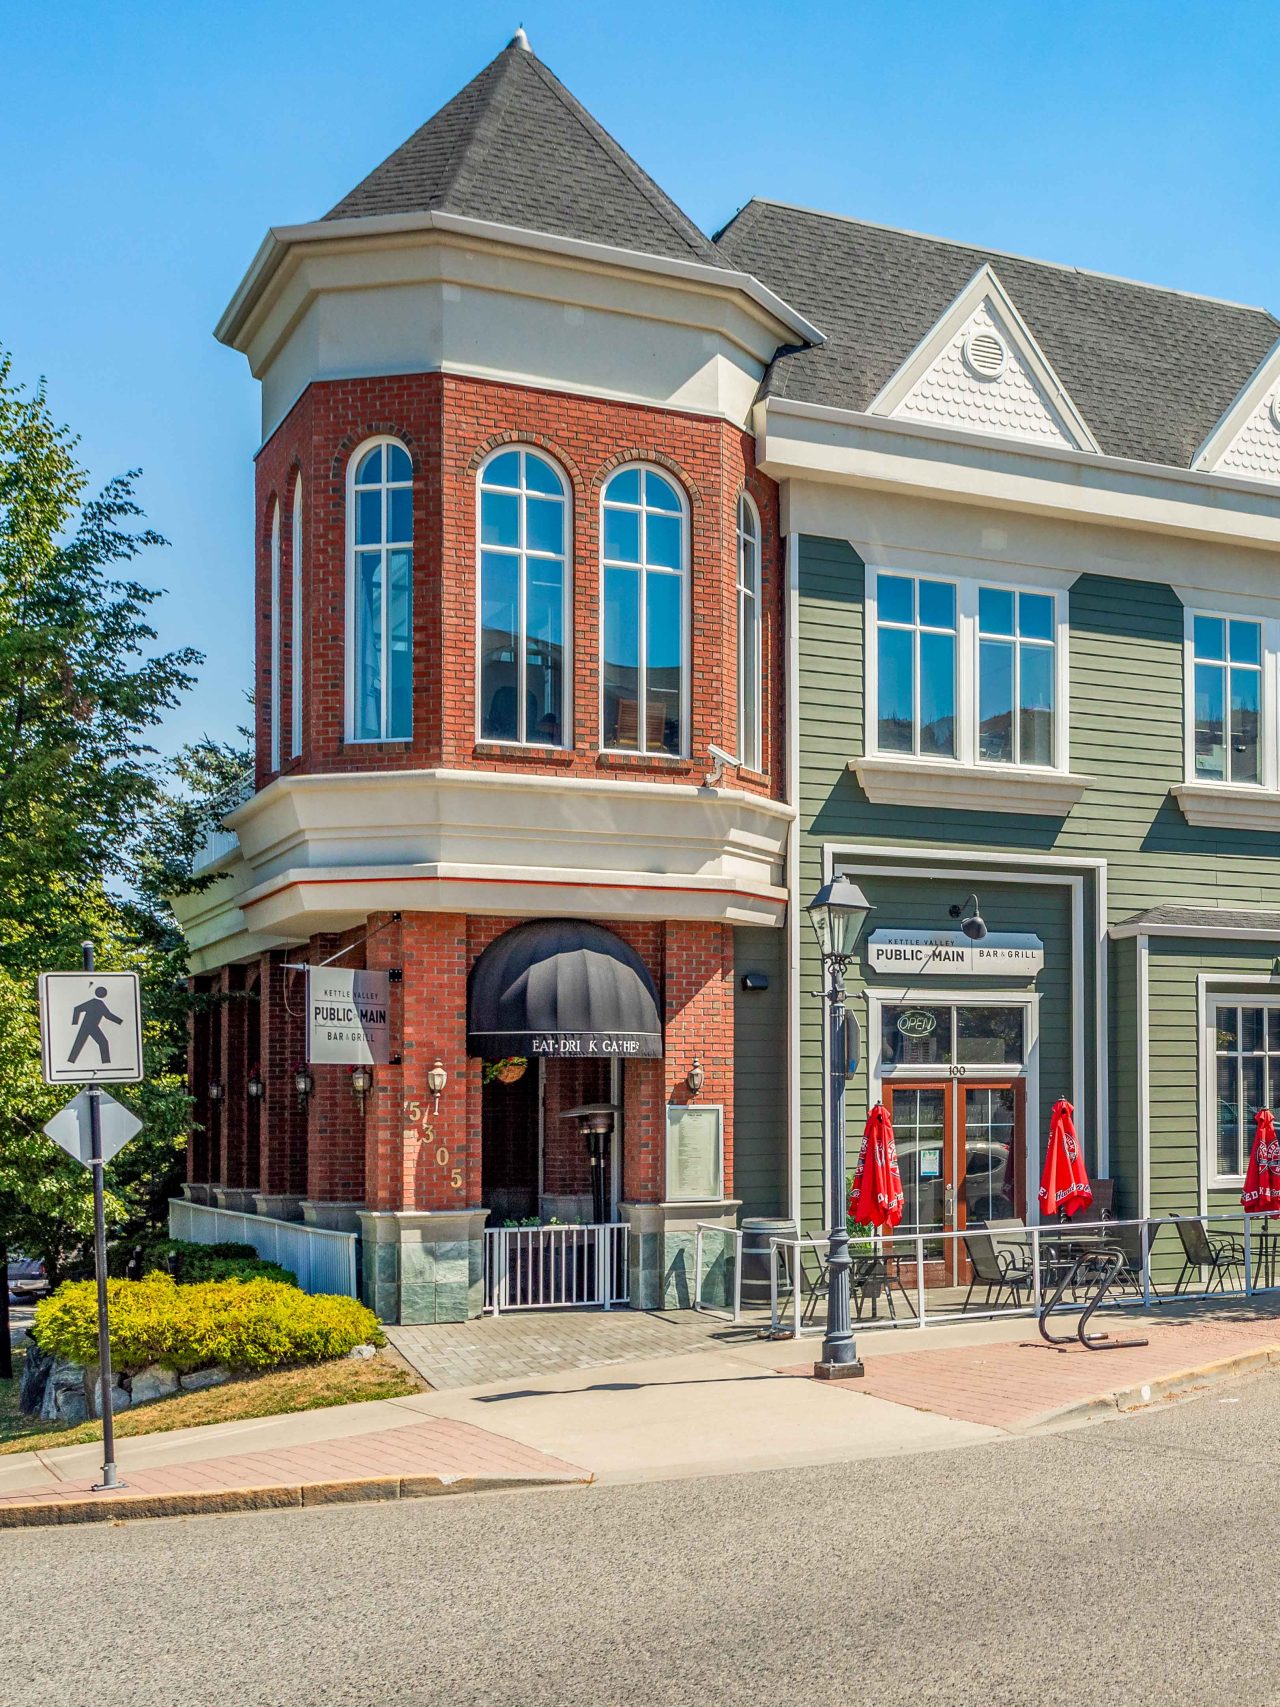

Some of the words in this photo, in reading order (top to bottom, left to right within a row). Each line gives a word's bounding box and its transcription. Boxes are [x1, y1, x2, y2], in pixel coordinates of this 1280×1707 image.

[888, 938, 920, 946] KETTLE
[923, 939, 955, 947] VALLEY
[876, 949, 923, 961] PUBLIC
[931, 950, 965, 962] MAIN
[979, 950, 999, 958] BAR
[1007, 951, 1036, 959] GRILL
[324, 989, 351, 998] KETTLE
[353, 992, 379, 1000] VALLEY
[314, 1006, 353, 1022] PUBLIC
[360, 1009, 387, 1024] MAIN
[899, 1017, 932, 1030] OPEN
[327, 1031, 344, 1041] BAR
[351, 1033, 375, 1042] GRILL
[948, 1065, 966, 1076] 100
